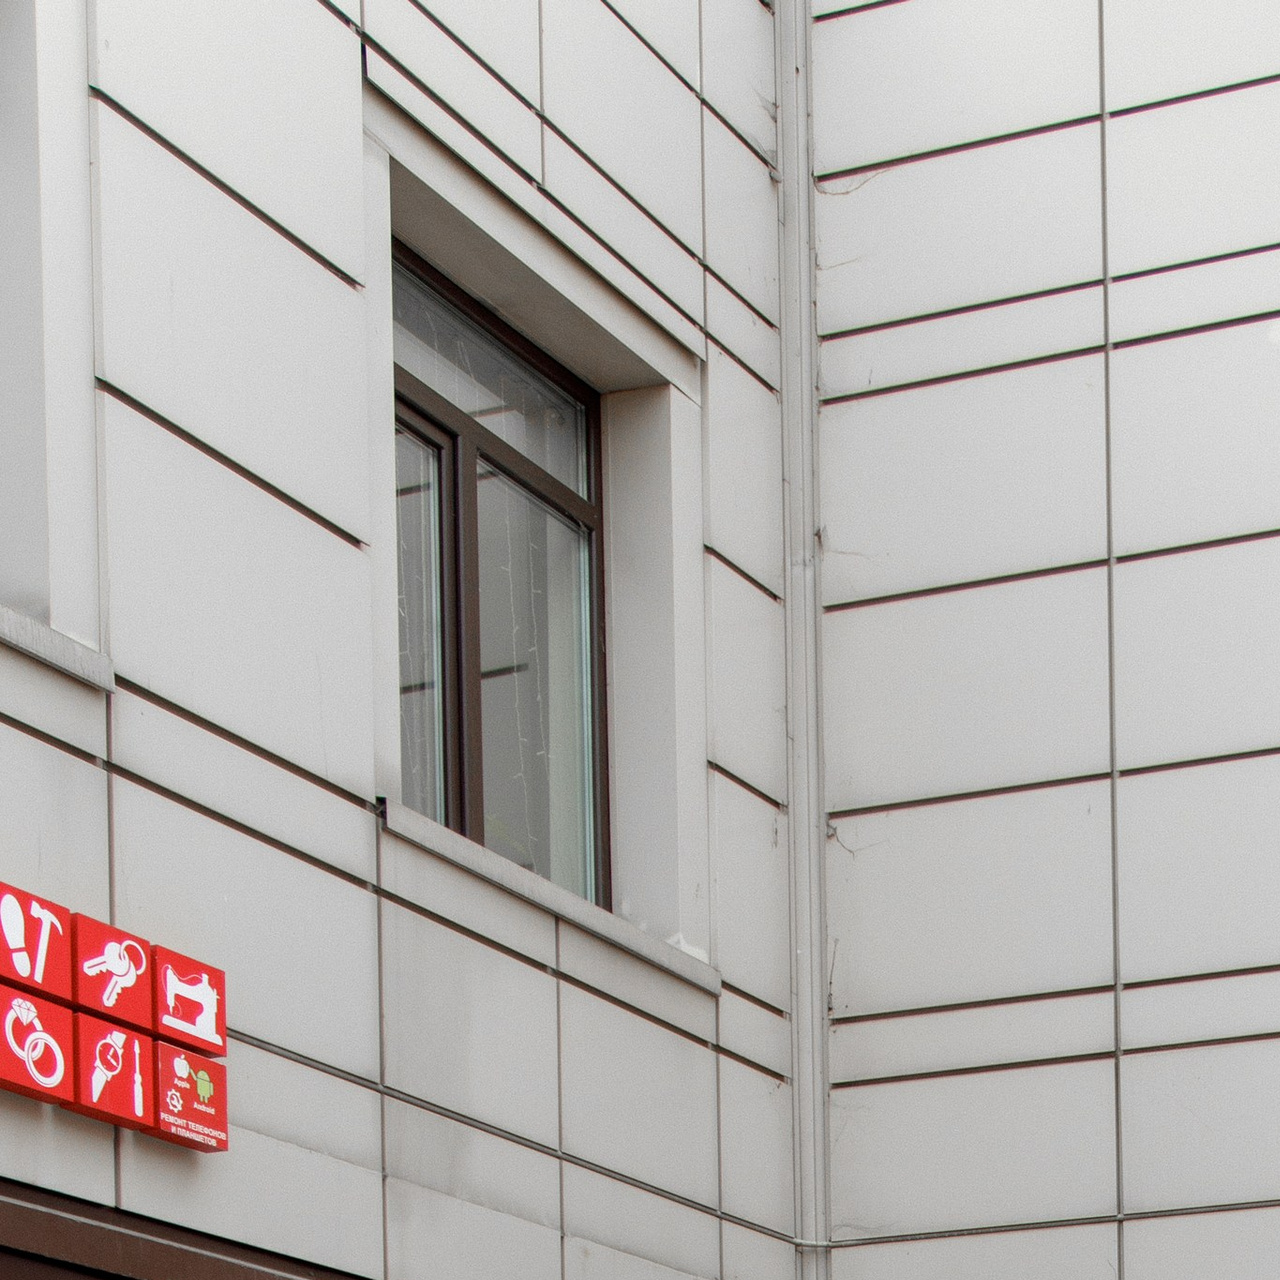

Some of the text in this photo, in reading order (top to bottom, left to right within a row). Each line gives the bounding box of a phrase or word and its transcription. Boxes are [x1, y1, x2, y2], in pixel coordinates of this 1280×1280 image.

[194, 1102, 215, 1115] Android
[160, 1111, 227, 1141] РЕМОНТ ТЕЛЕФОНОВ
[177, 1127, 217, 1147] ПЛАНШЕТОВ
